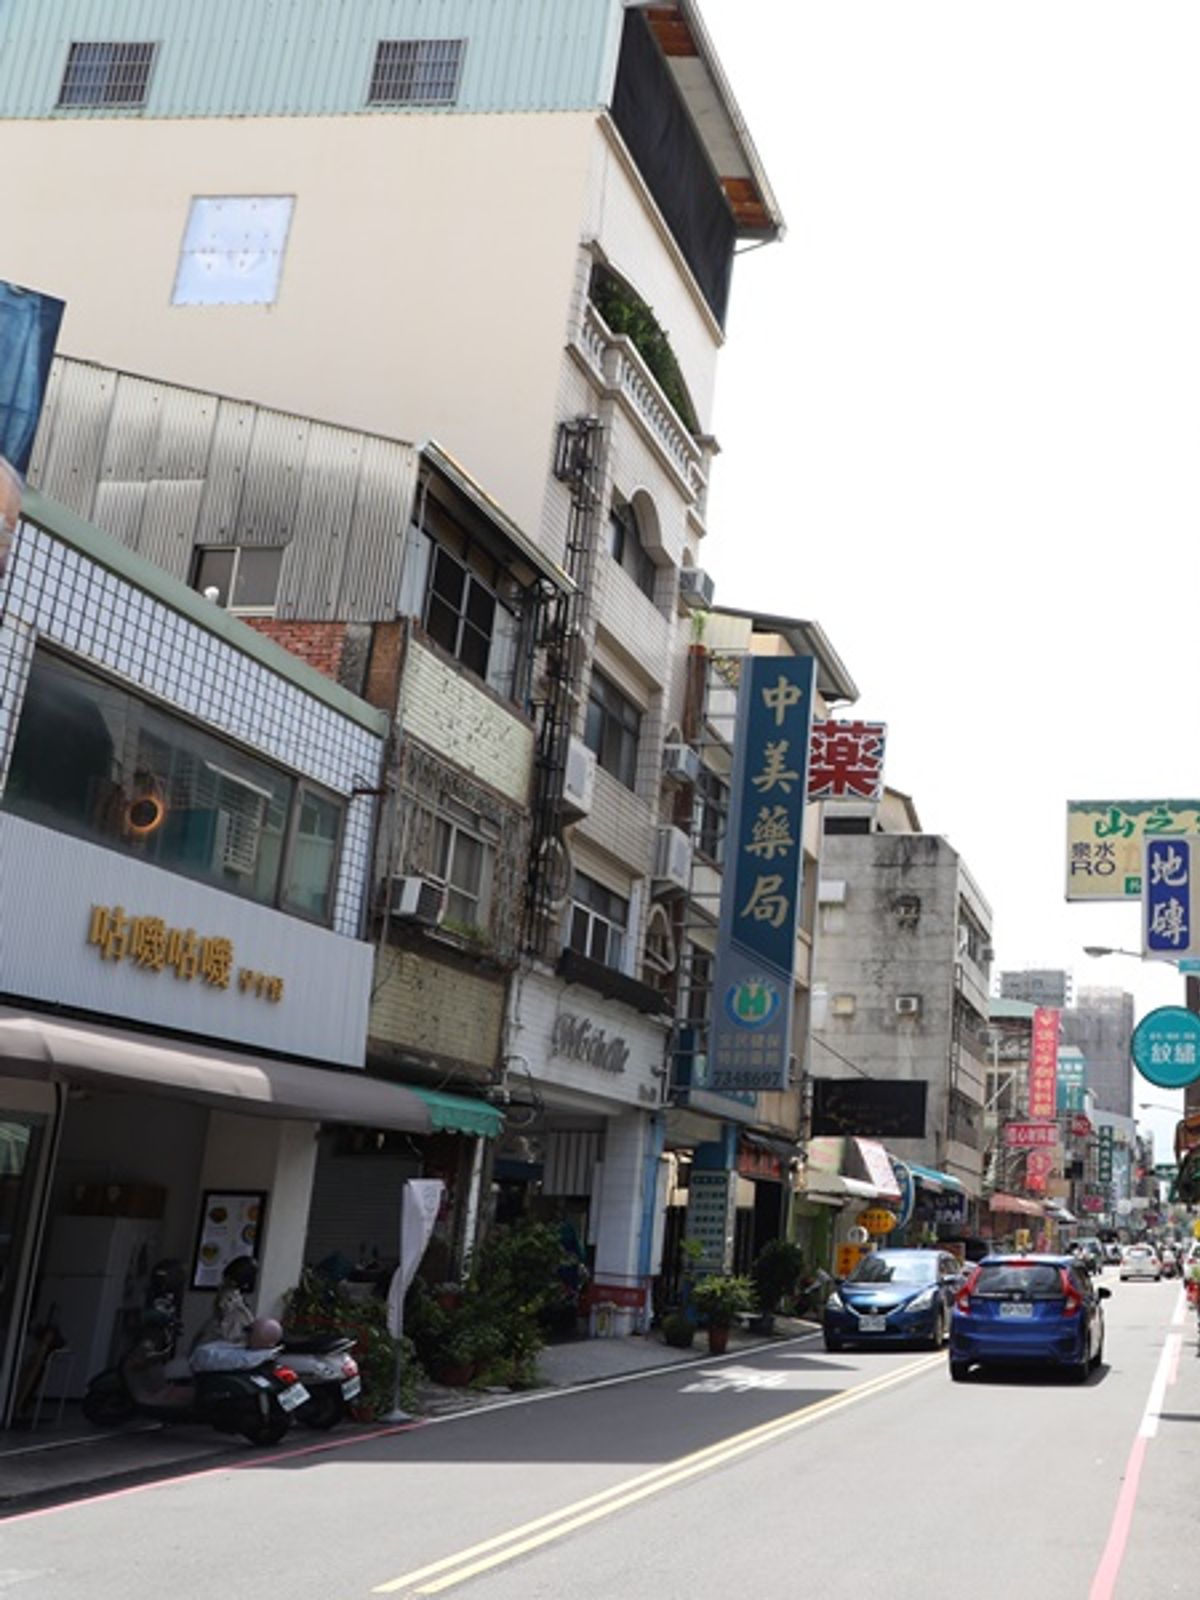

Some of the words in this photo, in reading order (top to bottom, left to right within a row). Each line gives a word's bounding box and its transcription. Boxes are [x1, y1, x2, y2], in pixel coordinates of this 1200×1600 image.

[739, 675, 803, 929] 中美藥局
[1071, 861, 1116, 876] RO
[1150, 846, 1188, 946] 地磚
